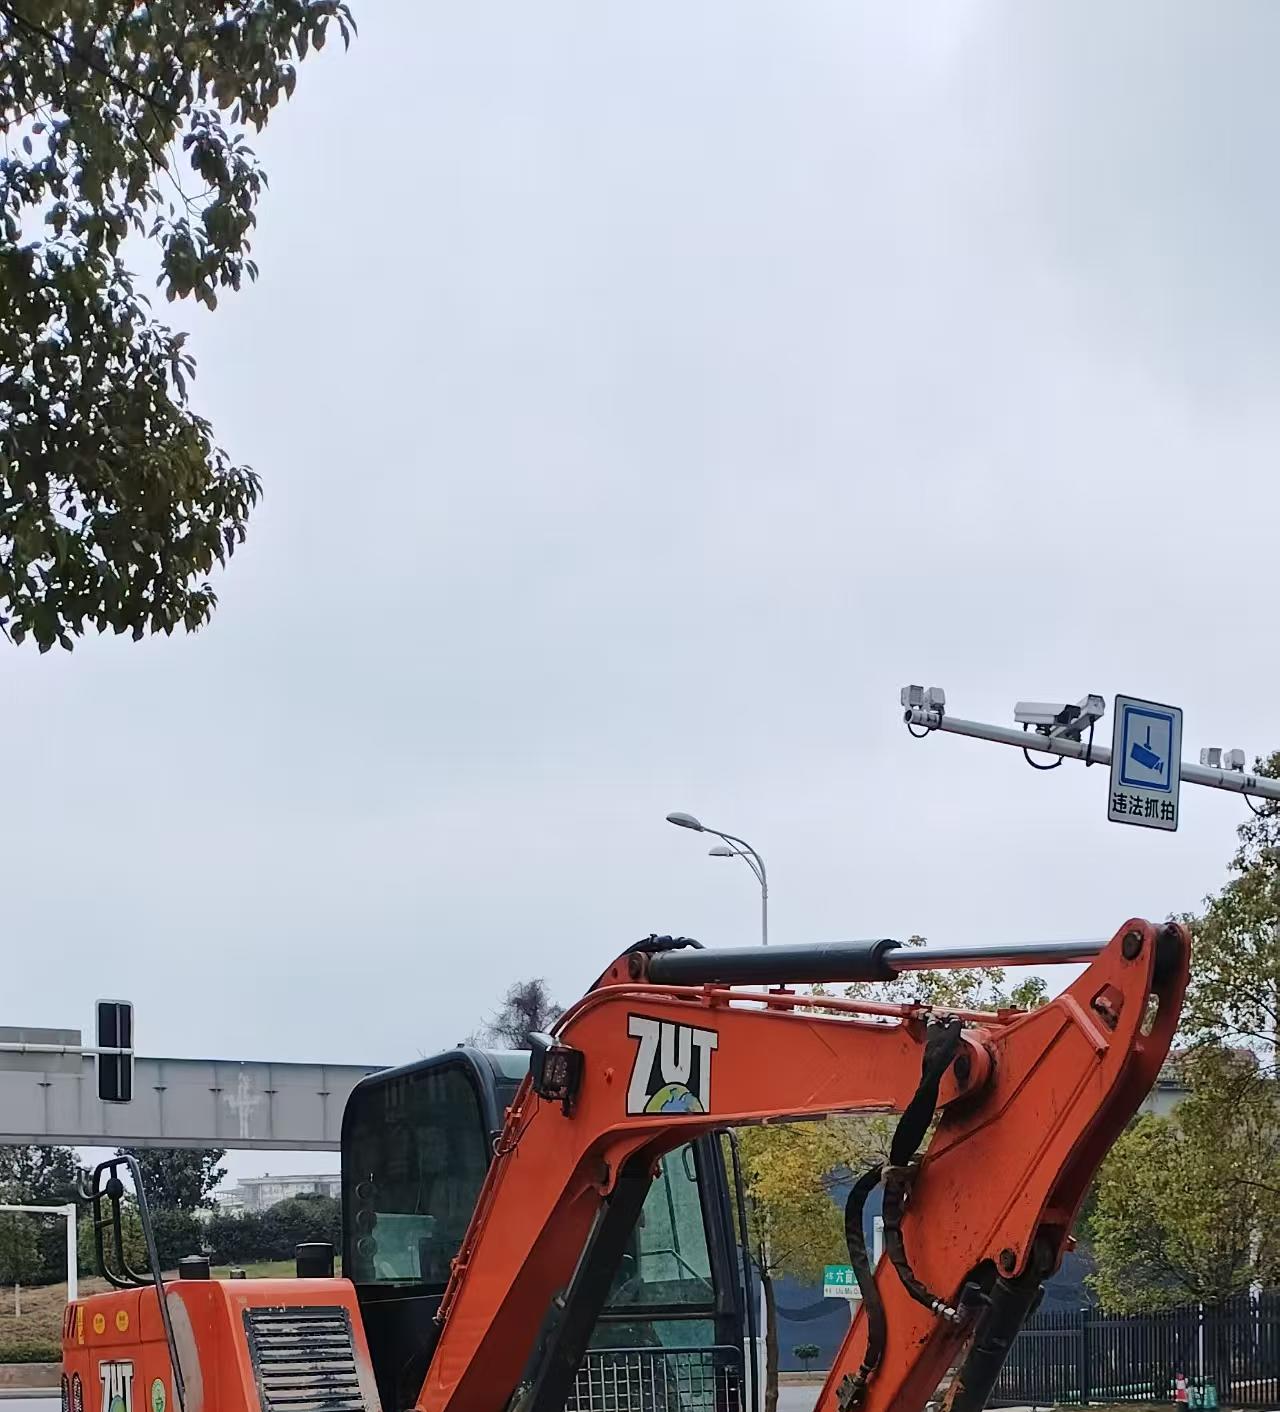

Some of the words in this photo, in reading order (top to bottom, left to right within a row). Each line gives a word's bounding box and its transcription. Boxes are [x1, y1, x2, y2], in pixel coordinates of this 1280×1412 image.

[1112, 793, 1175, 821] 违法抓拍
[627, 1013, 718, 1115] ZUT
[836, 1268, 858, 1284] 六亩
